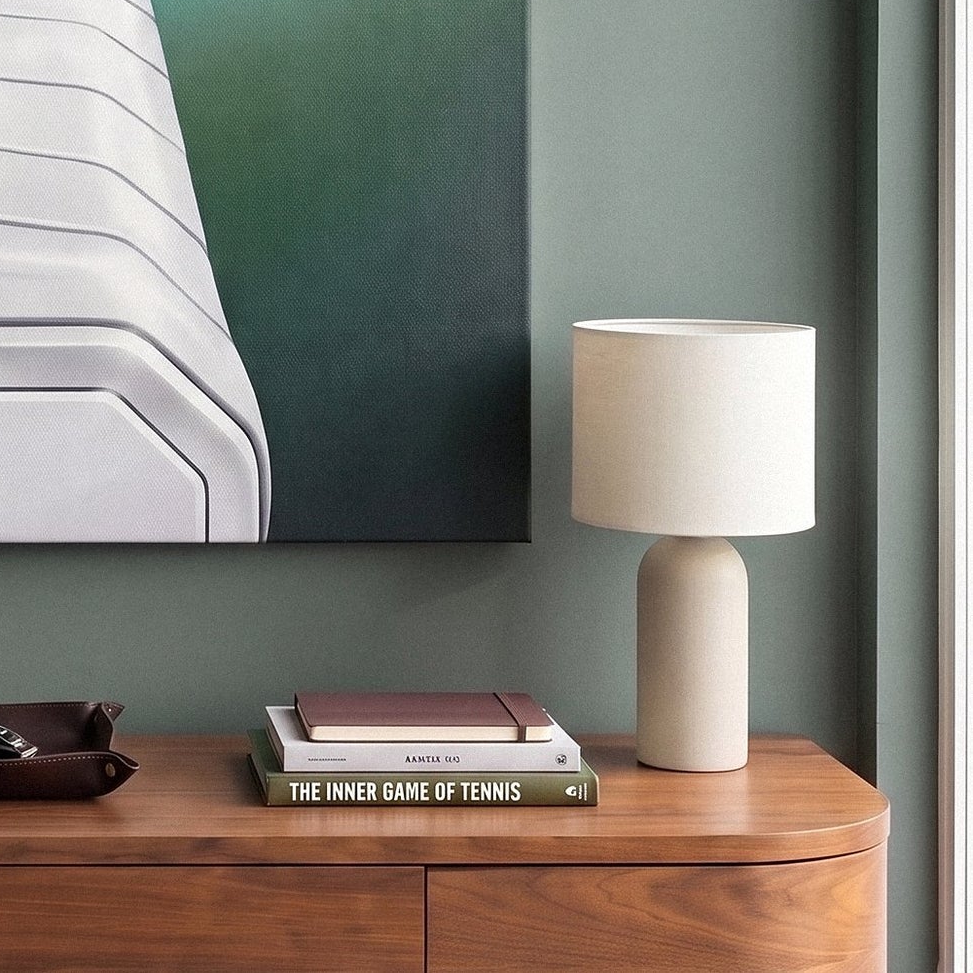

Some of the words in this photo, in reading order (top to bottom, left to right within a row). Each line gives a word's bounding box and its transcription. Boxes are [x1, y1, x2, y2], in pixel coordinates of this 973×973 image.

[289, 782, 321, 801] THE
[327, 782, 377, 801] INNER
[382, 782, 429, 801] GAME
[435, 782, 456, 801] OF
[460, 782, 521, 801] TENNIS
